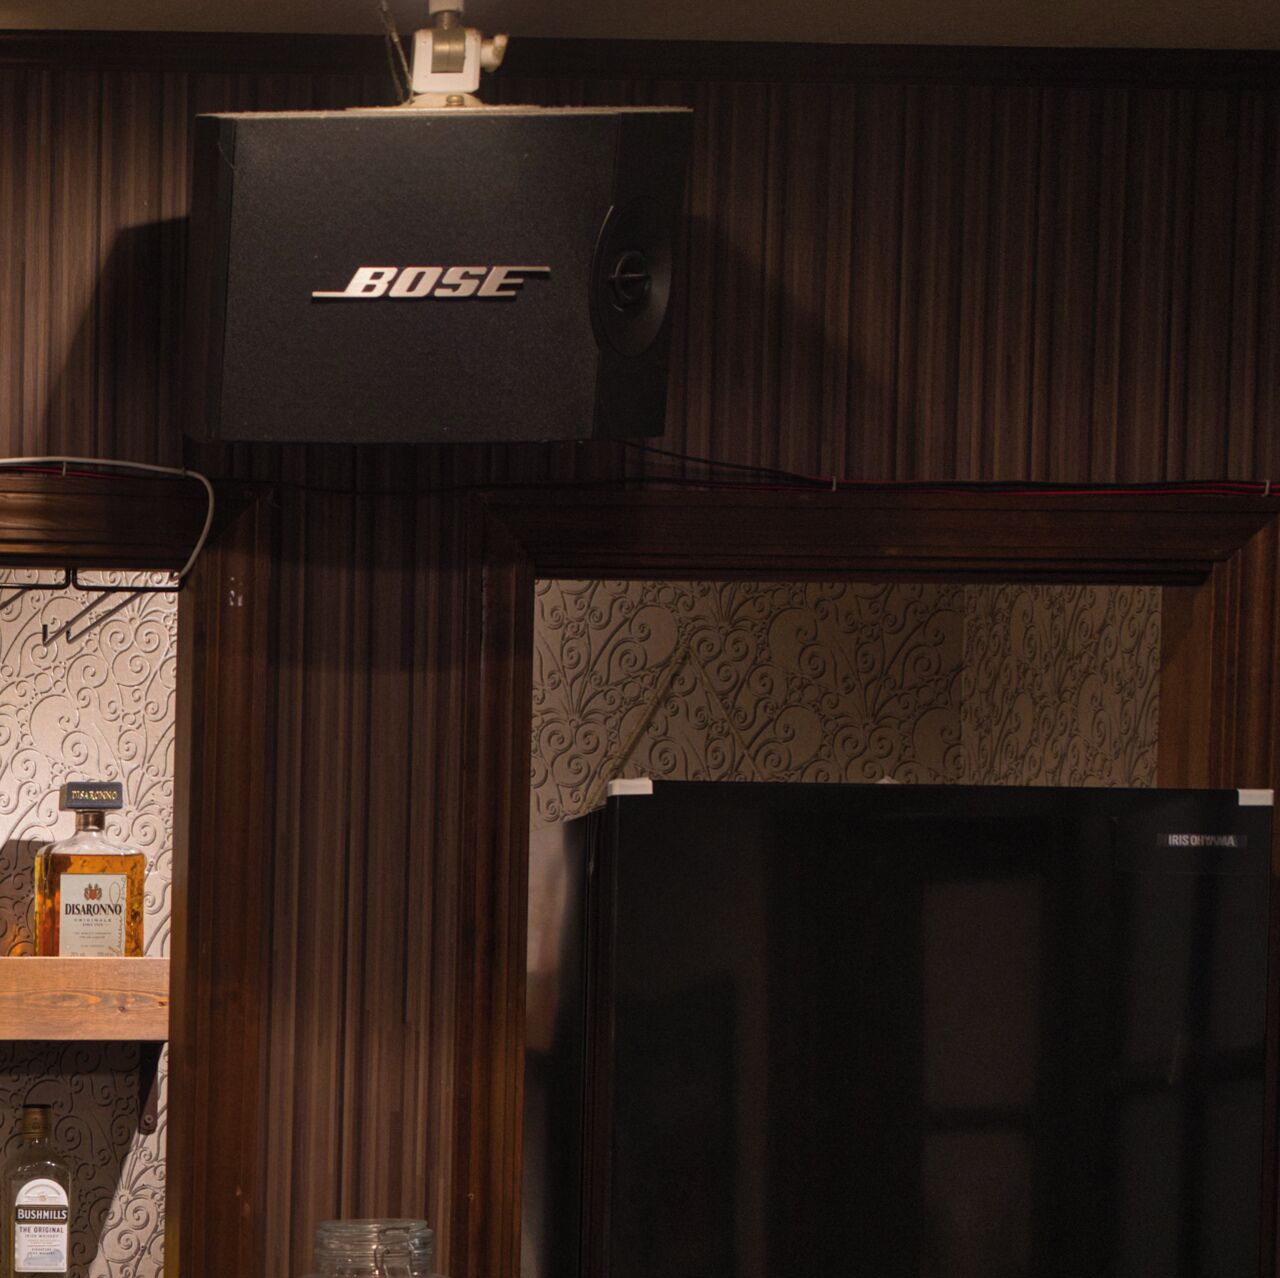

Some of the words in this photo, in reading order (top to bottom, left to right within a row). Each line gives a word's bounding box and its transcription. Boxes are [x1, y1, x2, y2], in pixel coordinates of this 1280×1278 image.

[312, 266, 551, 298] BOSE
[71, 790, 118, 801] DISARONNO
[1168, 834, 1189, 846] IRIS
[64, 903, 122, 917] DISARONNO
[17, 1208, 68, 1220] BUSHMILLS
